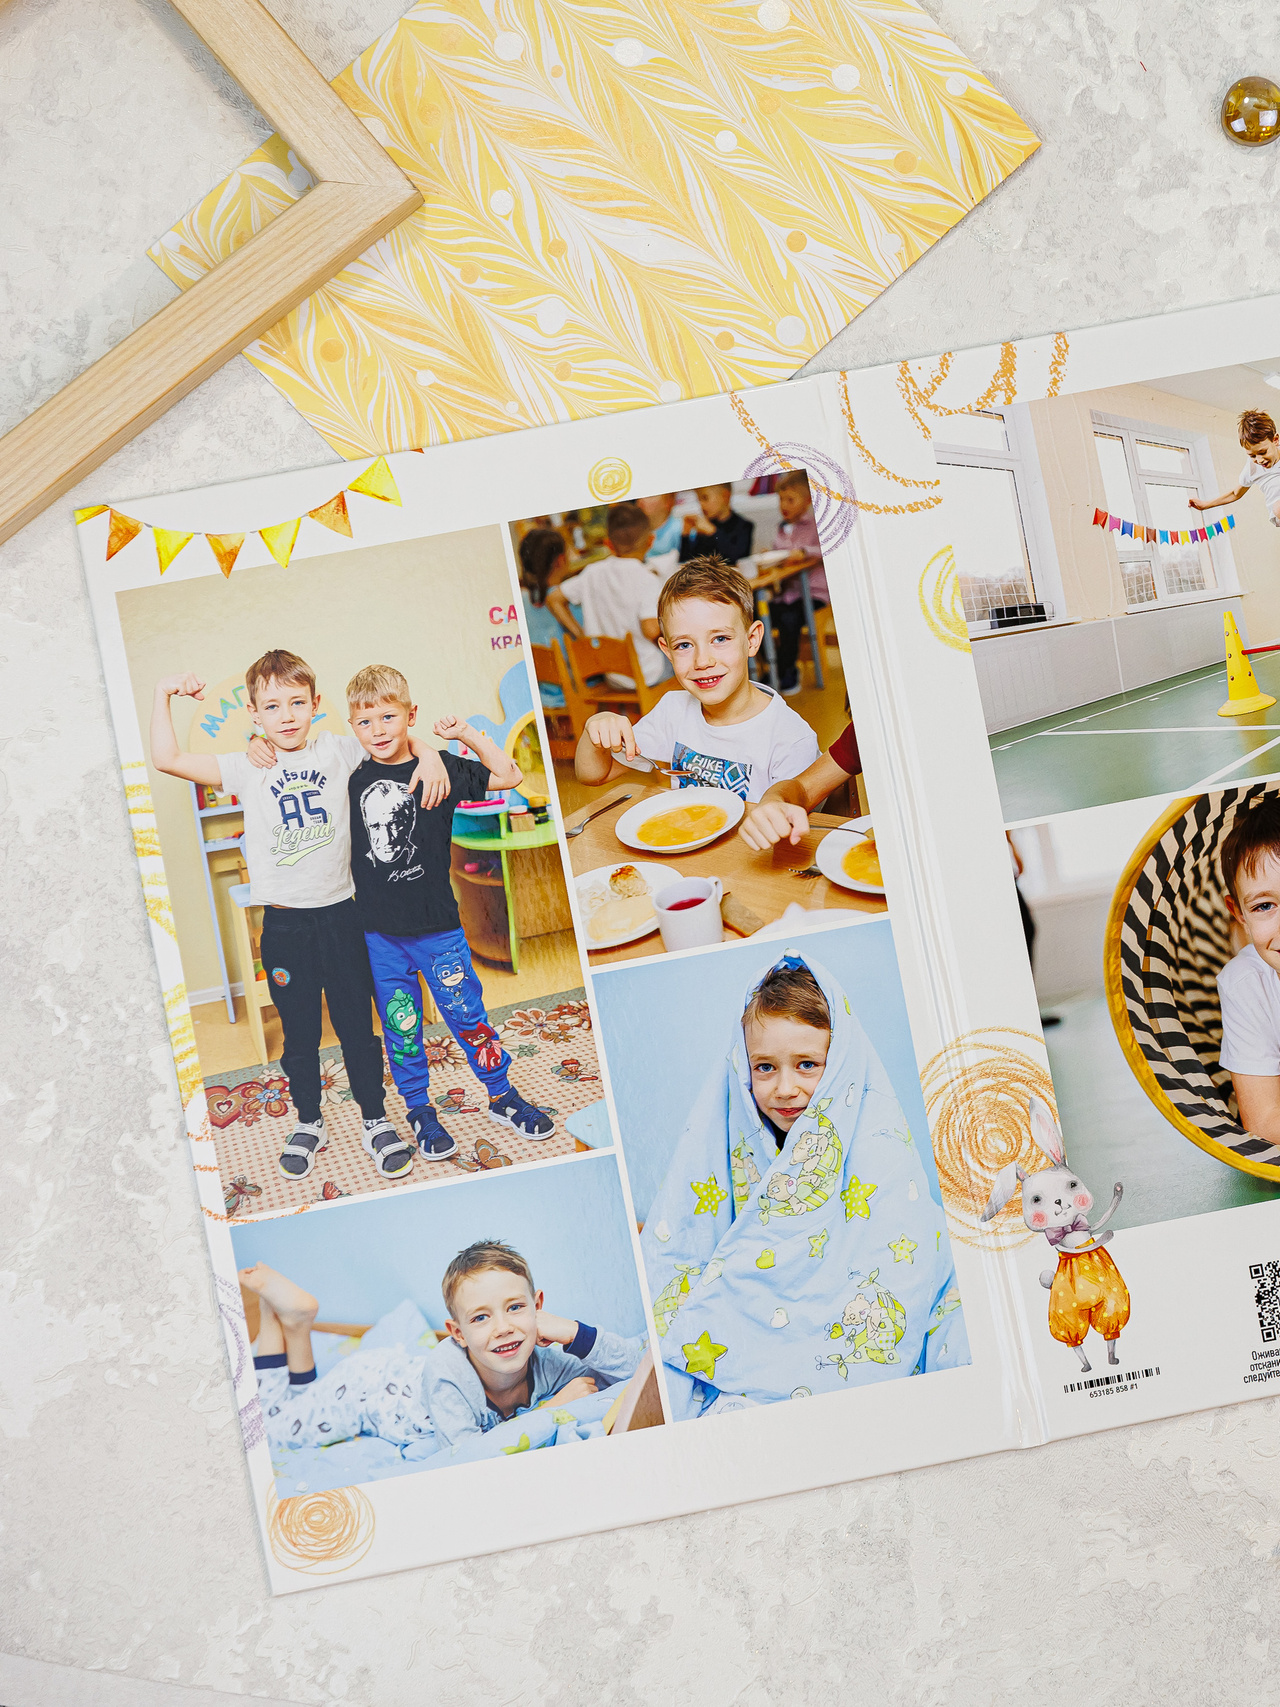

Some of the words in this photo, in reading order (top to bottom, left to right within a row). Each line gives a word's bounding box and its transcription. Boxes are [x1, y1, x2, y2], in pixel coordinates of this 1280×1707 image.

[692, 755, 724, 773] HIKE
[682, 762, 721, 785] MORE
[270, 813, 335, 855] Legend
[1243, 1369, 1280, 1384] следуйте
[1089, 1388, 1114, 1398] 653185
[1115, 1384, 1128, 1393] 858
